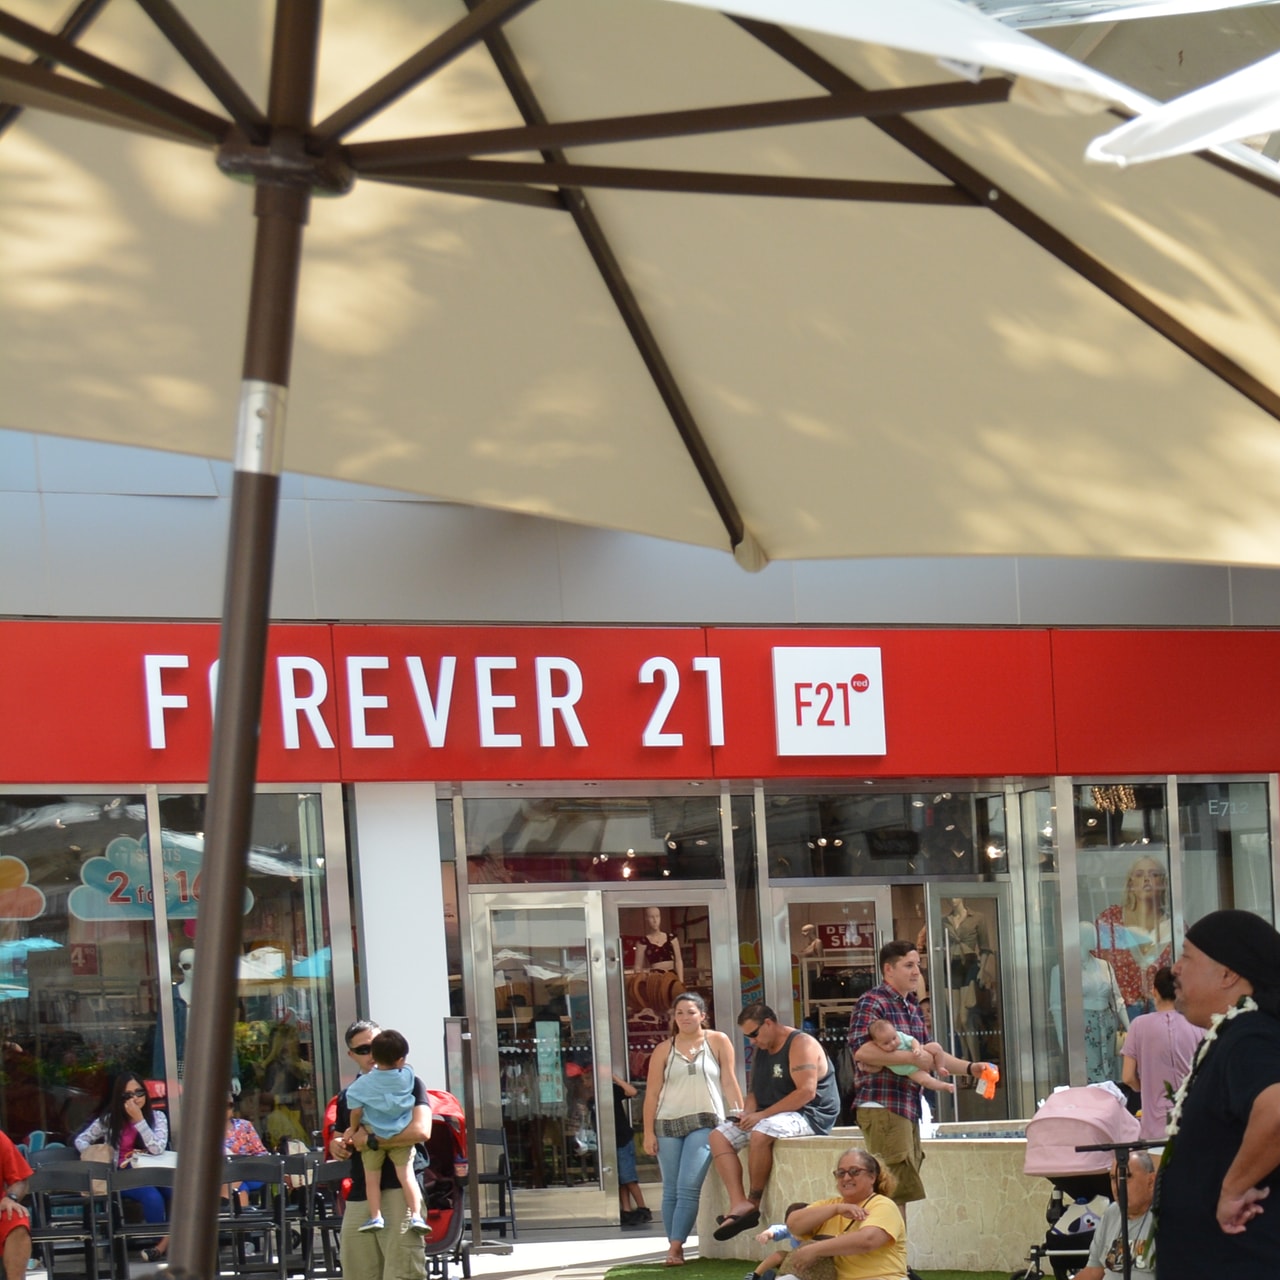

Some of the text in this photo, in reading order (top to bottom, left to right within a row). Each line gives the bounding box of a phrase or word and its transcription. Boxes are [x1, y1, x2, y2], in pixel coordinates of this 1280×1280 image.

[144, 655, 725, 749] FREVER 21
[794, 682, 850, 726] F21
[106, 871, 131, 903] 2
